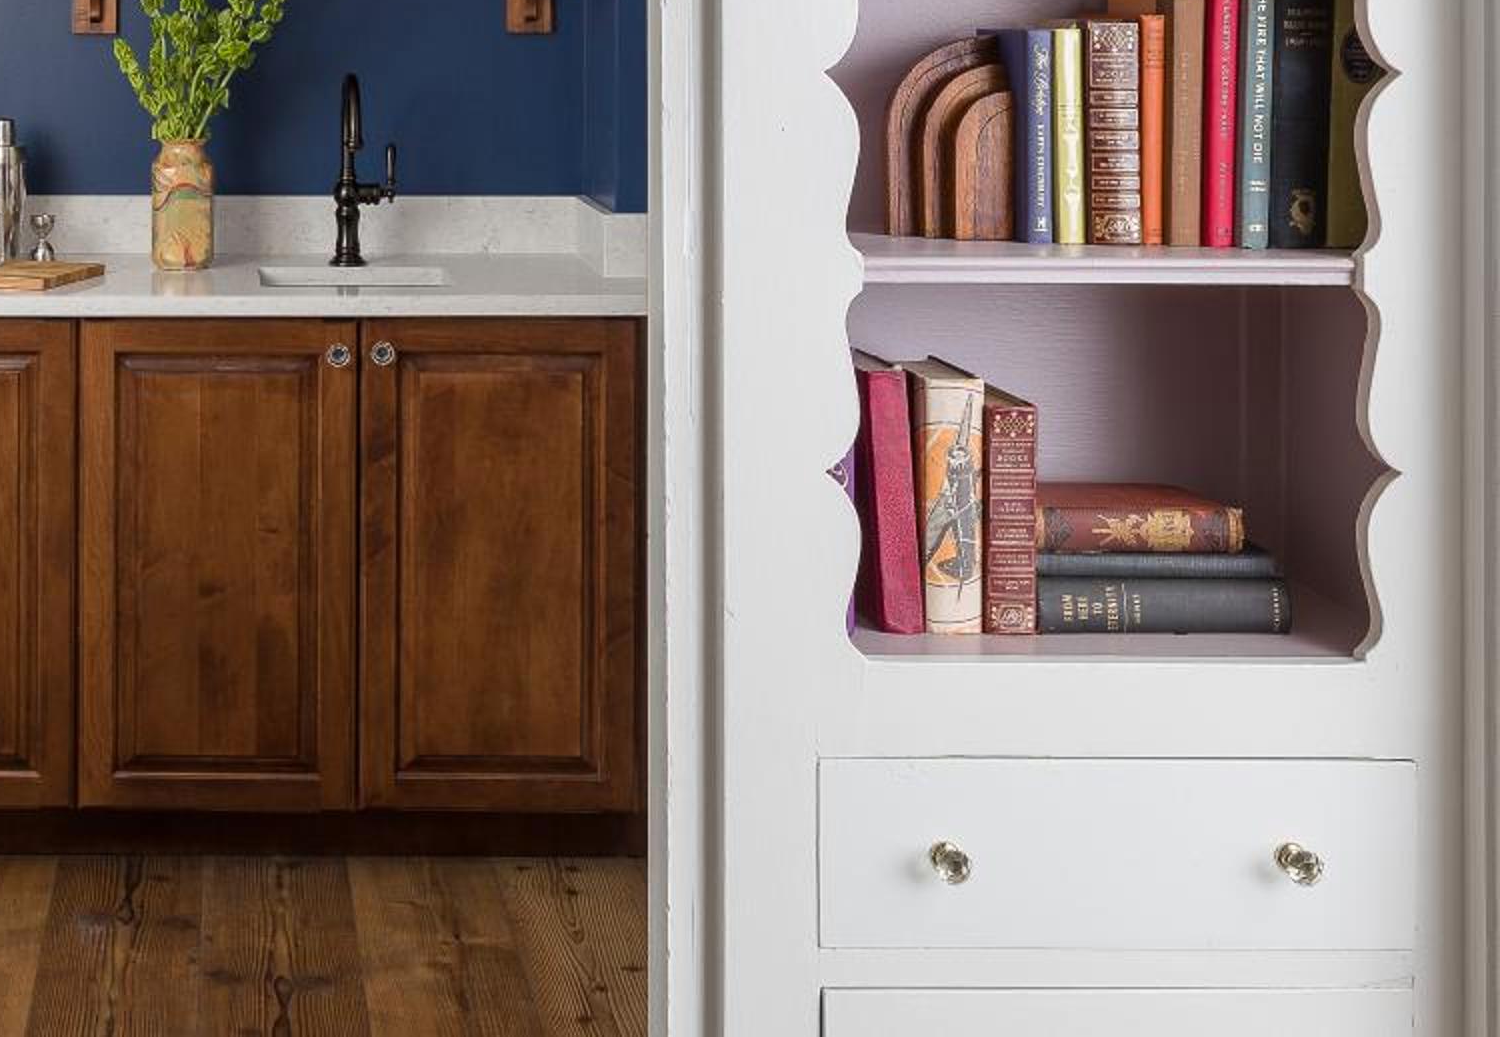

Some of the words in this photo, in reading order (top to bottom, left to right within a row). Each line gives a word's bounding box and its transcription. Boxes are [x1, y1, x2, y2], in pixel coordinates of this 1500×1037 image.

[1256, 15, 1268, 46] FIRE
[1255, 49, 1267, 80] THAT
[1254, 82, 1266, 109] WILL
[1253, 113, 1265, 139] NOT
[1252, 141, 1264, 164] DIE
[1061, 594, 1074, 622] FROM
[1077, 595, 1089, 621] HERE
[1092, 602, 1104, 615] TO
[1106, 585, 1120, 631] ETERNITY
